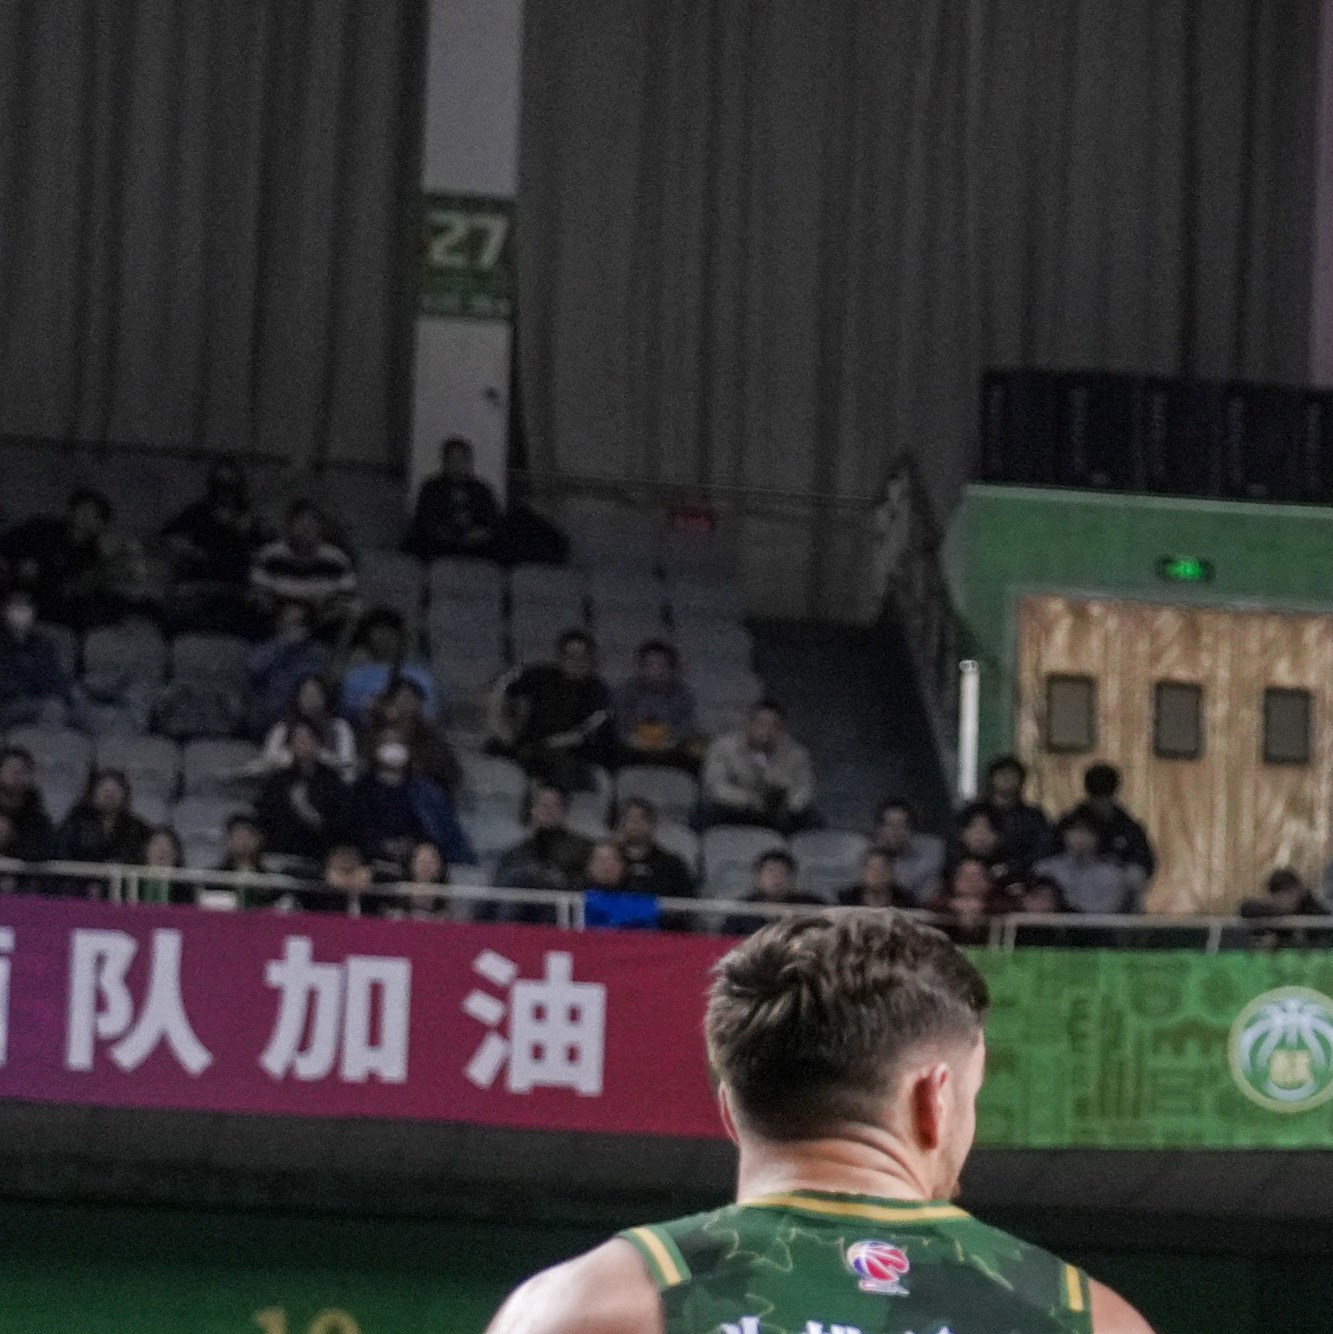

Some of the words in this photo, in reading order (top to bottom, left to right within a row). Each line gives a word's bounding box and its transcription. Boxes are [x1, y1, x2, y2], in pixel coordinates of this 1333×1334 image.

[428, 210, 508, 267] 27
[0, 927, 607, 1096] 队加油
